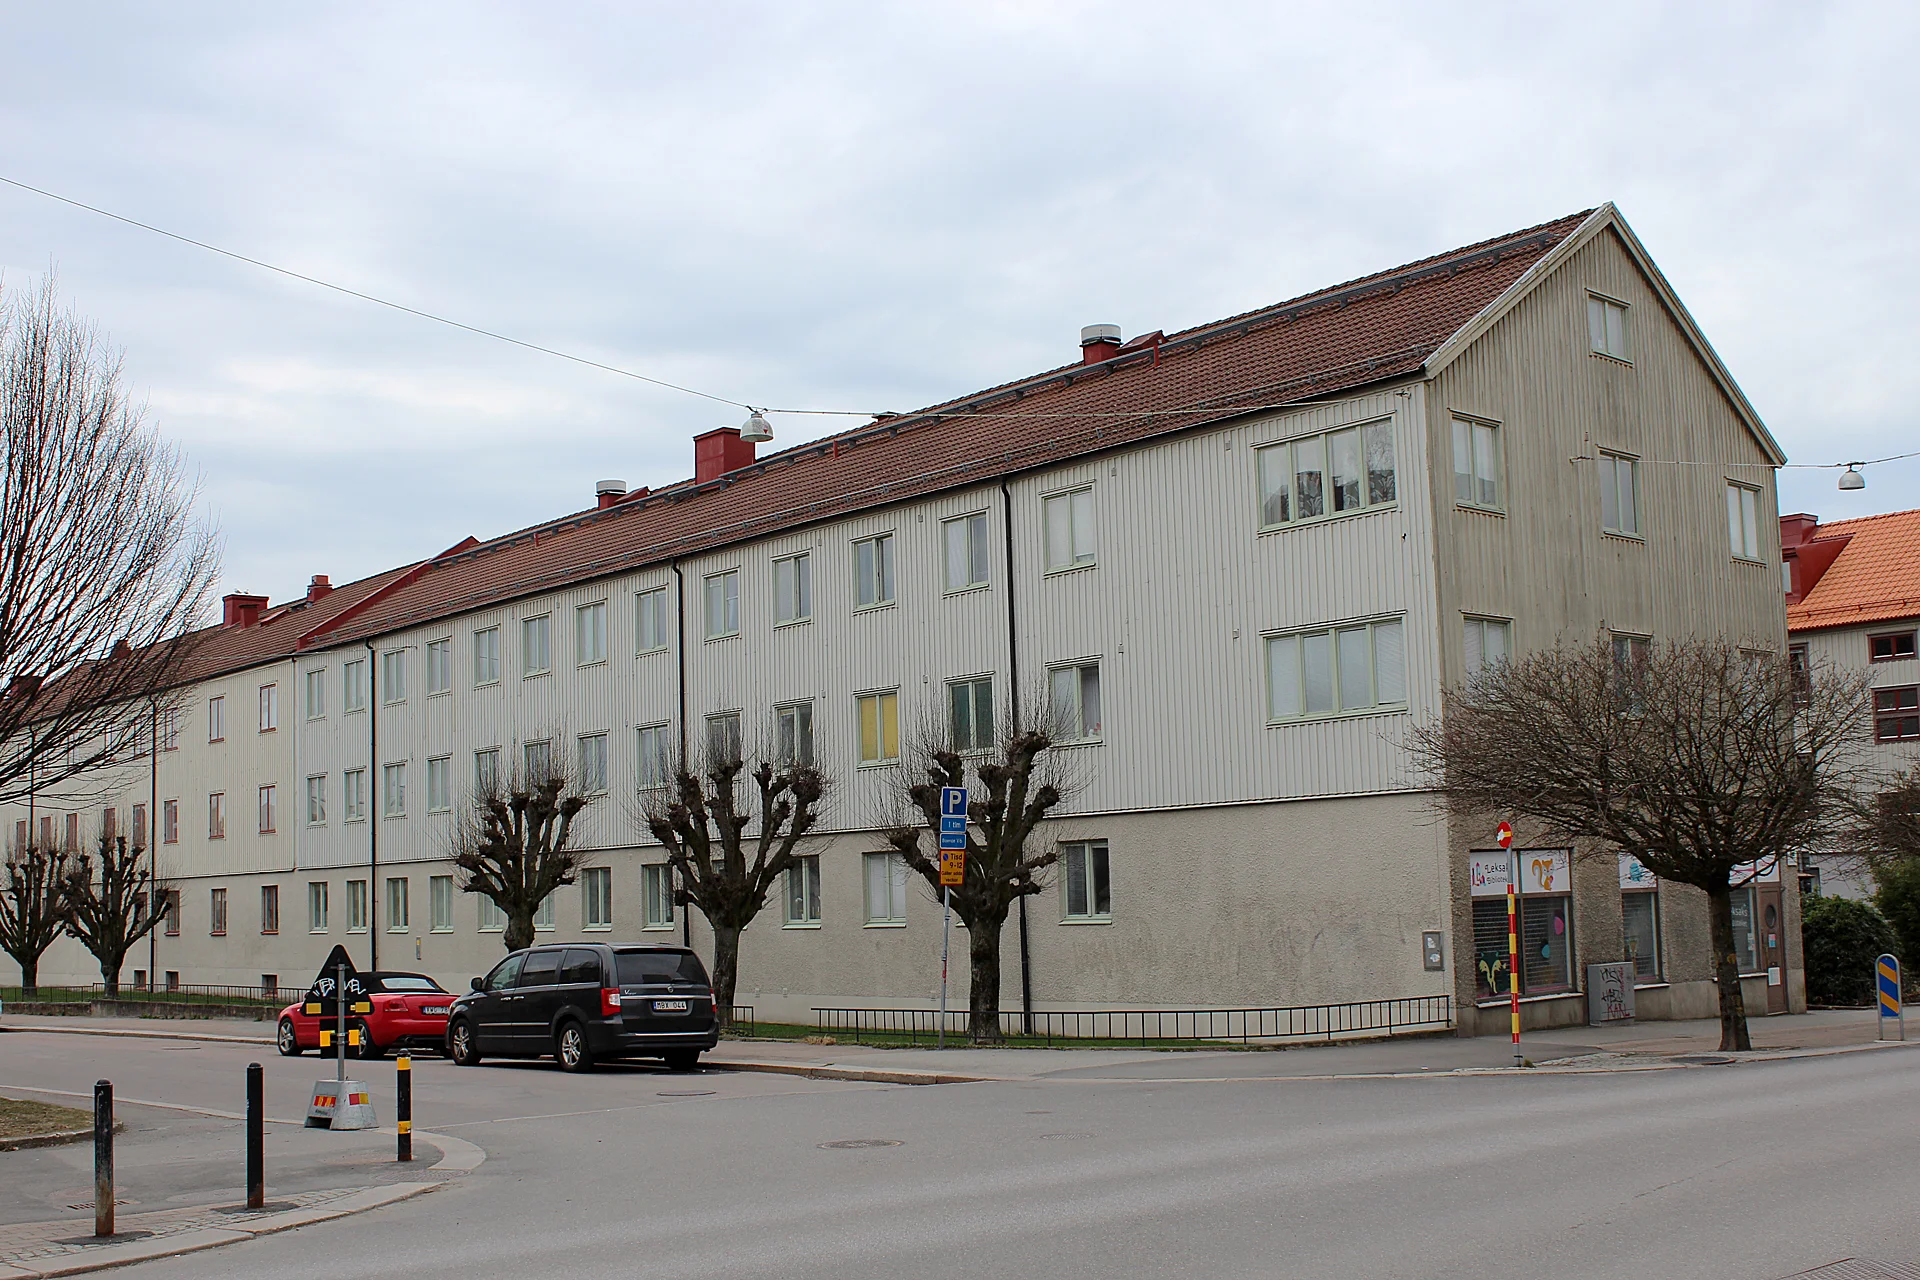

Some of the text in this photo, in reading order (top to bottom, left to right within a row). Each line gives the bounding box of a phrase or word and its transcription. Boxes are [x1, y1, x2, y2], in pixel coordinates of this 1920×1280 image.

[949, 791, 962, 813] P
[949, 861, 962, 869] 9-12
[1484, 862, 1508, 874] Leksa
[657, 1001, 669, 1009] MBX
